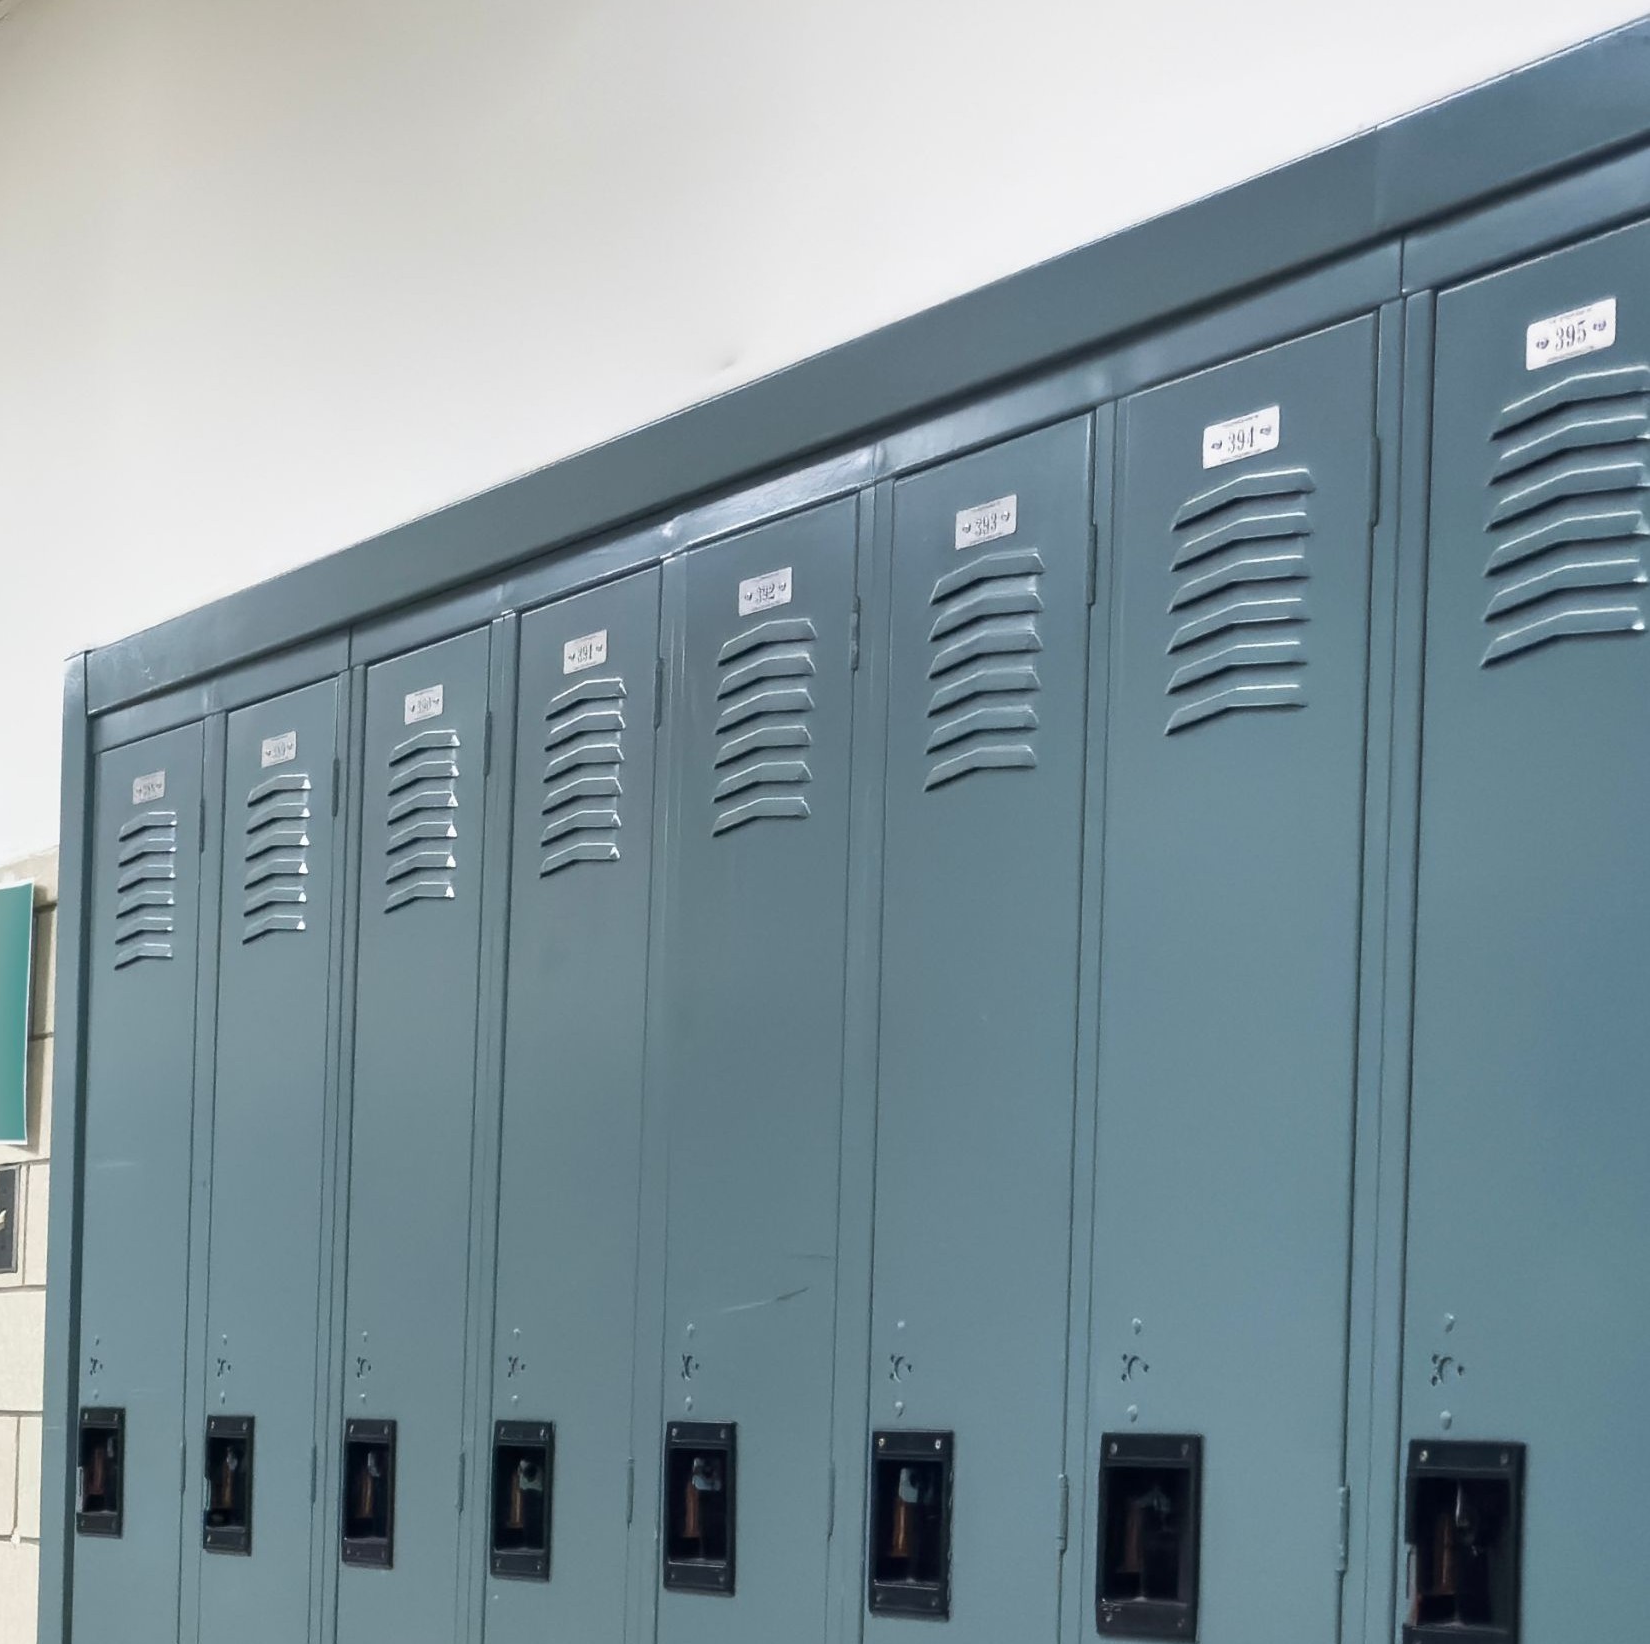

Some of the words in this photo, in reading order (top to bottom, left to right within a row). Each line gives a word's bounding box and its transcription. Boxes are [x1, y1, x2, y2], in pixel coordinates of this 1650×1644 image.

[1555, 319, 1586, 351] 395
[975, 512, 997, 536] 393
[756, 582, 775, 603] 392
